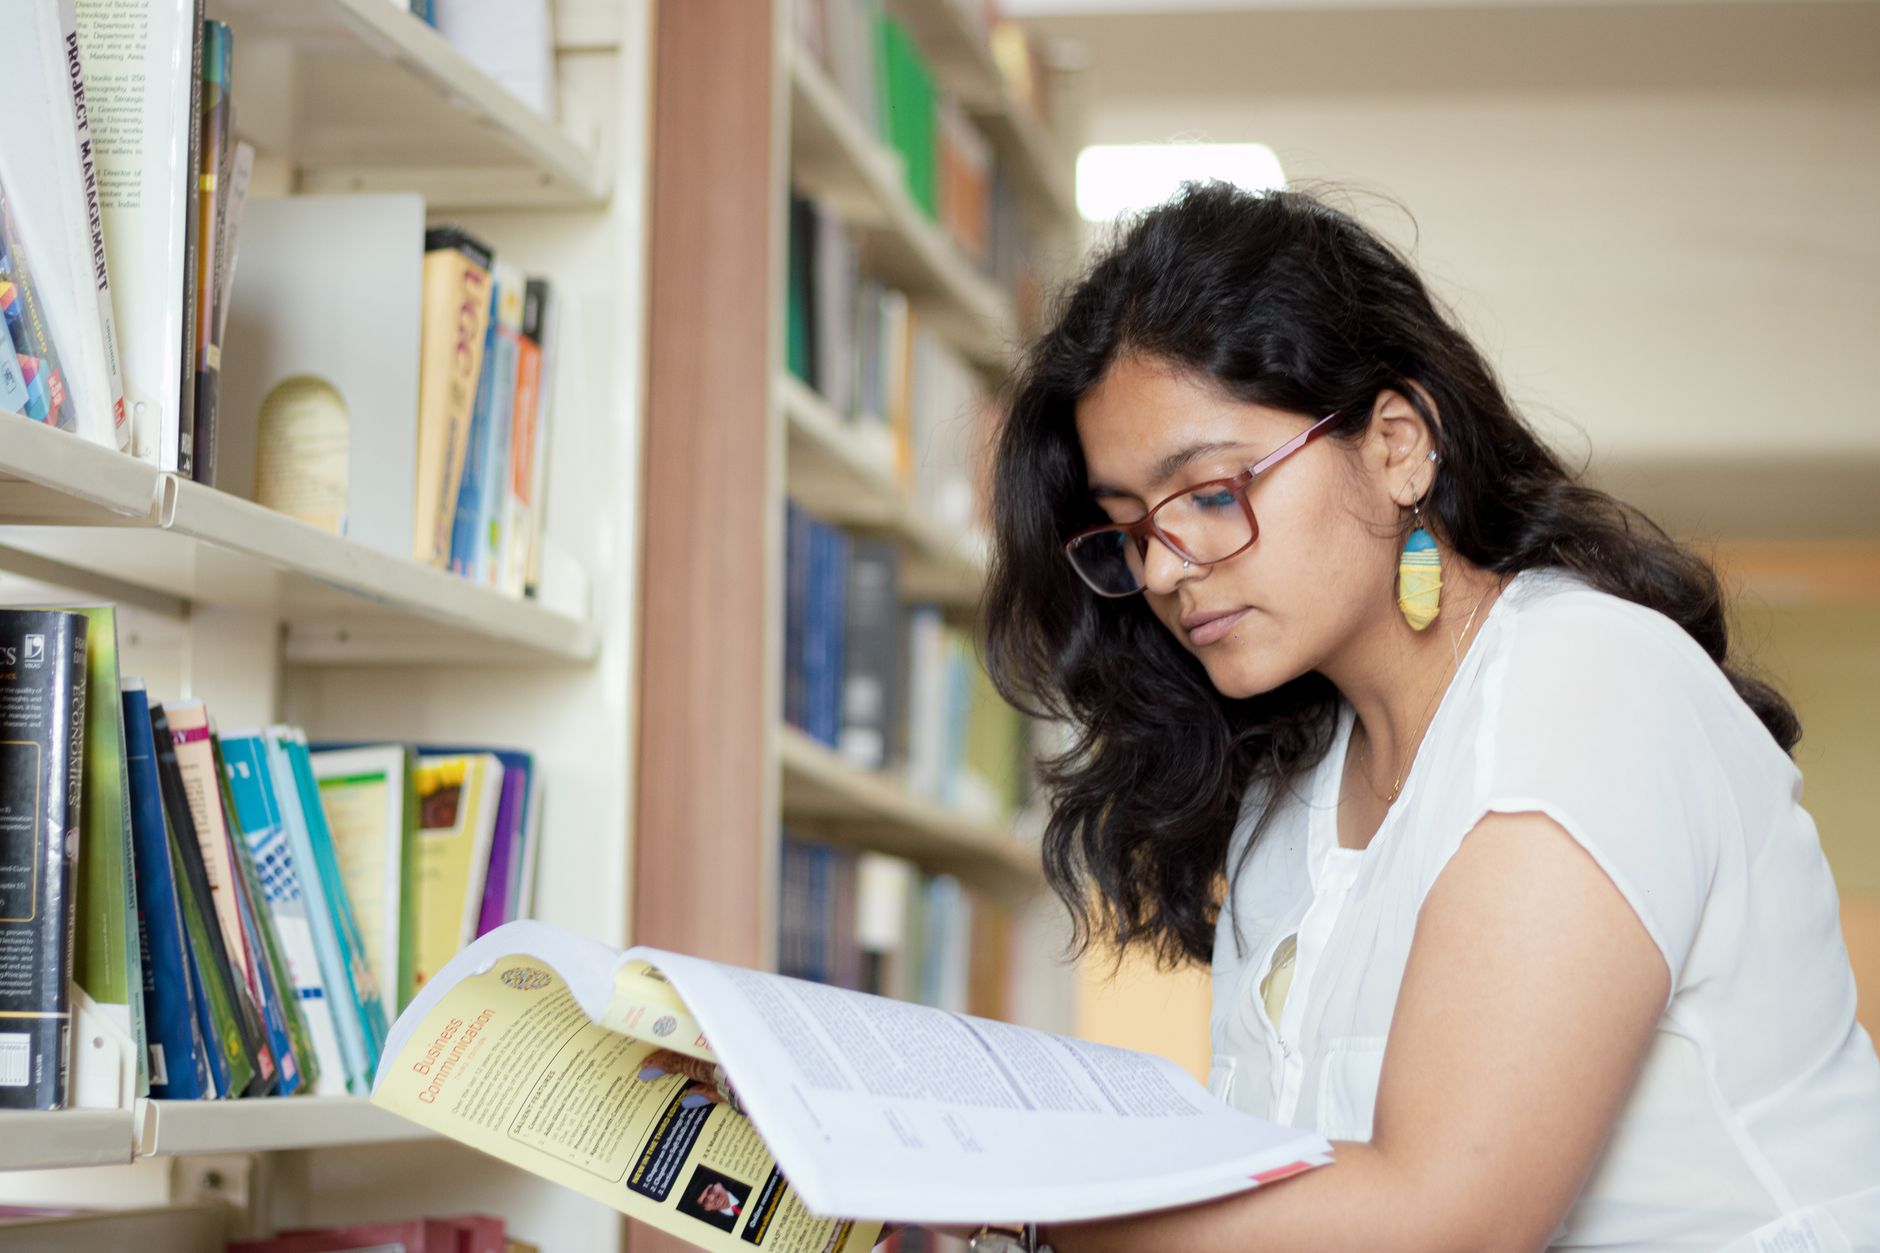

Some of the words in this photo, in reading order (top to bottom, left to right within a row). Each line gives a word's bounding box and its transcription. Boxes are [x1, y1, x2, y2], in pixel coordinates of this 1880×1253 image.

[93, 21, 135, 30] Department
[93, 32, 135, 40] Department
[66, 30, 88, 131] PROJECT
[80, 139, 109, 291] MANAGEMENT
[69, 686, 81, 806] ECONOMICS
[413, 1018, 462, 1075] Business
[419, 1009, 496, 1104] Communication
[511, 1102, 534, 1135] SALIENT
[530, 1069, 555, 1104] FEATURES
[551, 1101, 566, 1121] Global
[631, 1164, 645, 1184] NEW
[641, 1154, 650, 1165] IN
[646, 1140, 657, 1155] THE
[654, 1116, 671, 1141] THIRD
[645, 1158, 661, 1183] Chapter
[660, 1117, 683, 1151] Technology
[707, 1117, 727, 1148] Madhukar
[652, 1161, 669, 1186] Chapter
[748, 1204, 764, 1228] Online
[759, 1174, 778, 1205] resources
